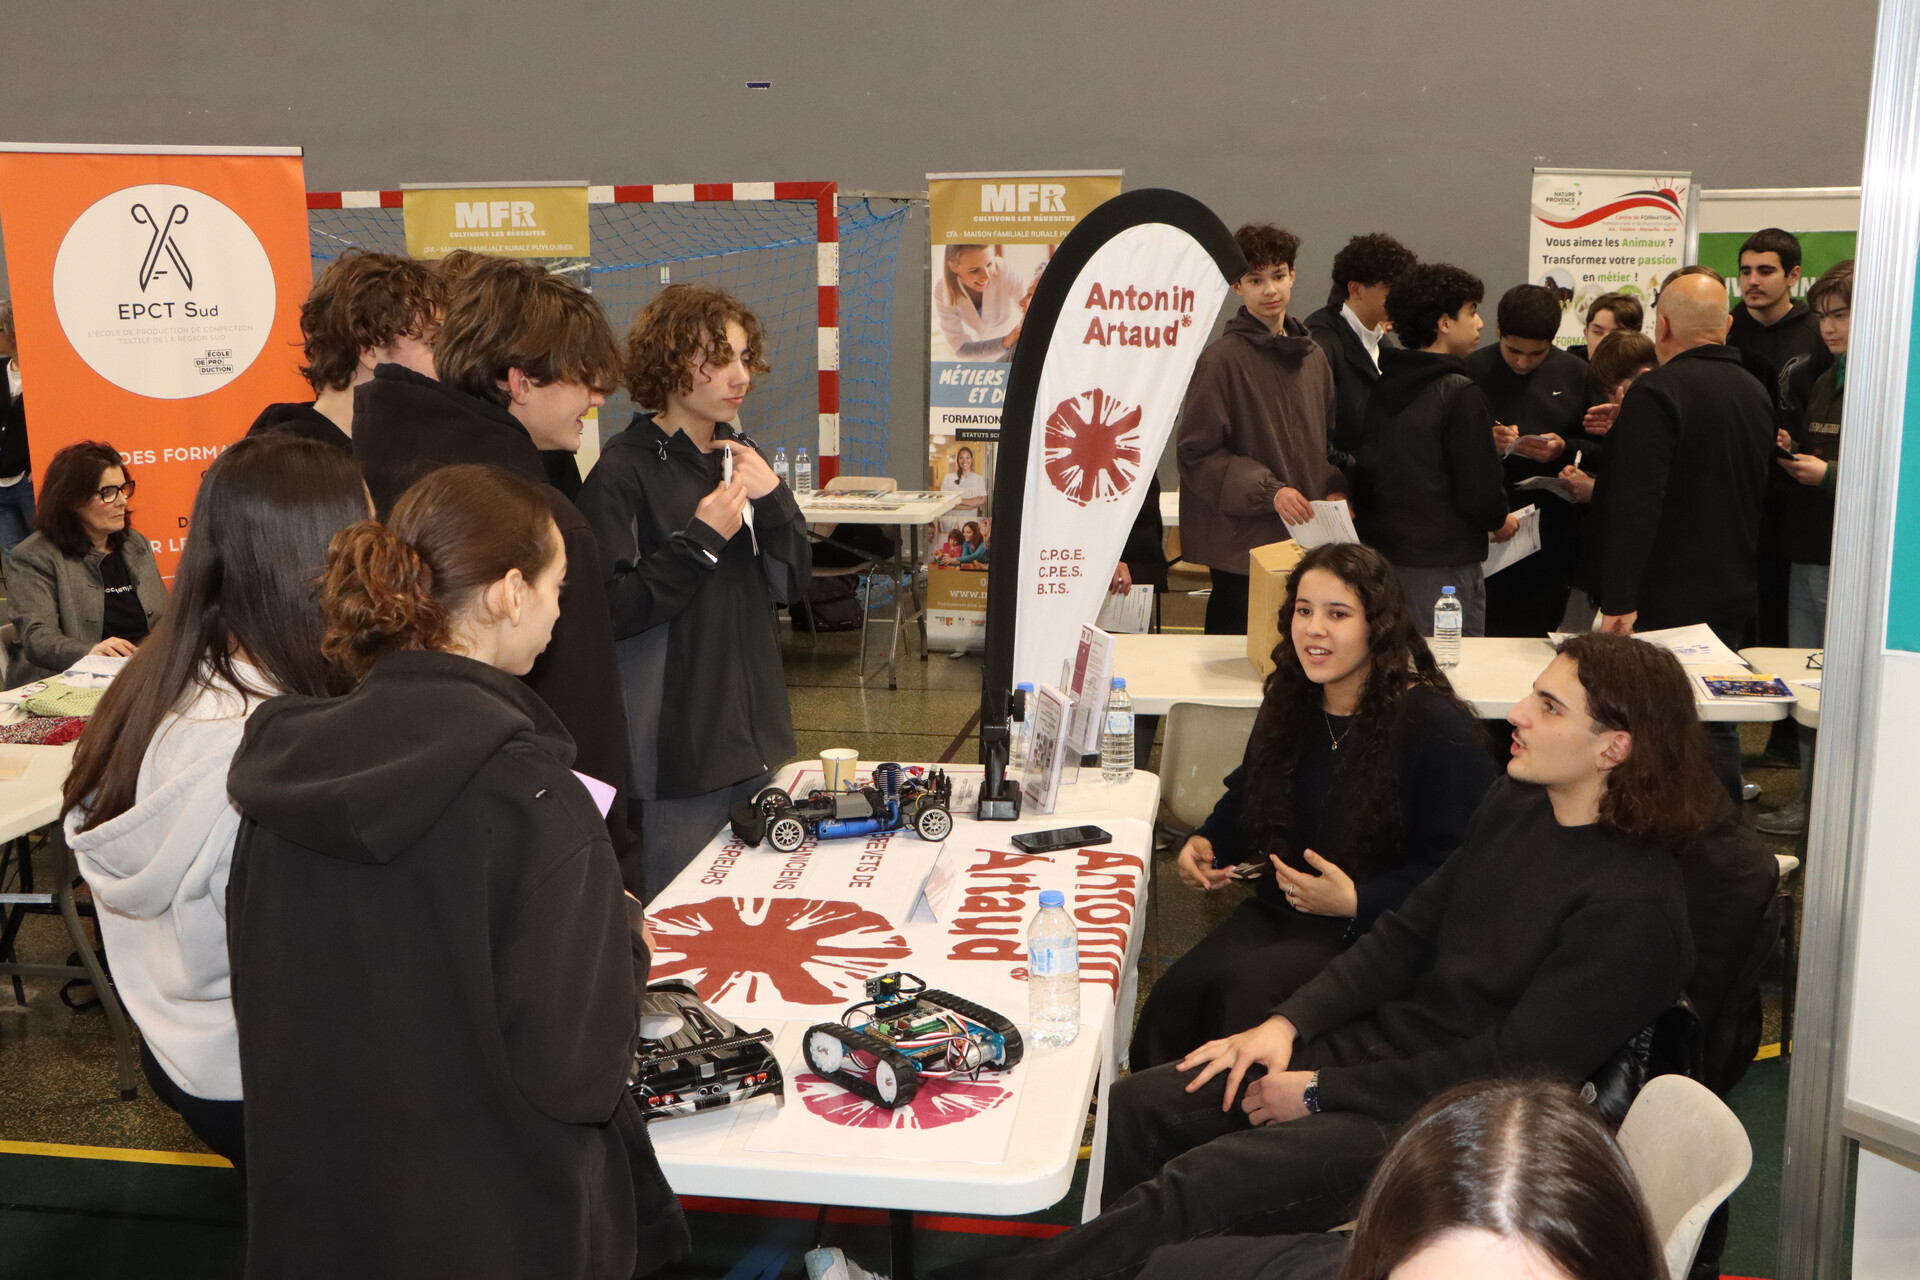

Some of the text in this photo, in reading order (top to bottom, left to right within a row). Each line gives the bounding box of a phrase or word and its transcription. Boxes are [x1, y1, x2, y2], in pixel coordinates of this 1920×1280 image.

[981, 183, 1067, 213] MFR
[454, 200, 537, 229] MFR
[1033, 213, 1076, 222] RÉUSSITES
[506, 229, 546, 237] RÉUSSITES
[963, 230, 992, 238] MAISON
[993, 230, 1030, 238] FAMILIALE
[1031, 230, 1059, 238] RURALE
[469, 244, 504, 252] FAMILIALE
[504, 243, 531, 251] RURALE
[531, 243, 574, 251] PUYLOUBIER
[1545, 237, 1571, 247] Vous
[1573, 236, 1603, 247] aimez
[1605, 237, 1620, 247] les
[1621, 236, 1666, 247] Animaux
[1542, 254, 1677, 266] Transformez votre passion
[1582, 273, 1595, 282] en
[1597, 271, 1631, 282] métier
[1084, 281, 1195, 313] Antonin
[118, 301, 219, 320] EPCT Sud
[123, 328, 134, 336] DE
[136, 326, 189, 336] PRODUCTION
[191, 325, 201, 334] DE
[203, 324, 253, 333] CONFECTION
[1082, 315, 1180, 349] Artaud
[119, 333, 226, 345] TEXTILE DE LA RÉGION SUD
[207, 349, 230, 358] ÉCOLE
[208, 358, 223, 366] PRO
[201, 365, 232, 374] DUCTION
[939, 364, 1006, 386] MÉTIERS
[968, 387, 989, 404] ET
[120, 450, 157, 466] DES
[1040, 549, 1086, 561] C.P.G.E.
[1038, 565, 1083, 578] C.P.E.S.
[1037, 582, 1069, 595] B.T.S.
[848, 832, 896, 888] BREVETS DE
[946, 848, 1056, 961] Artaud
